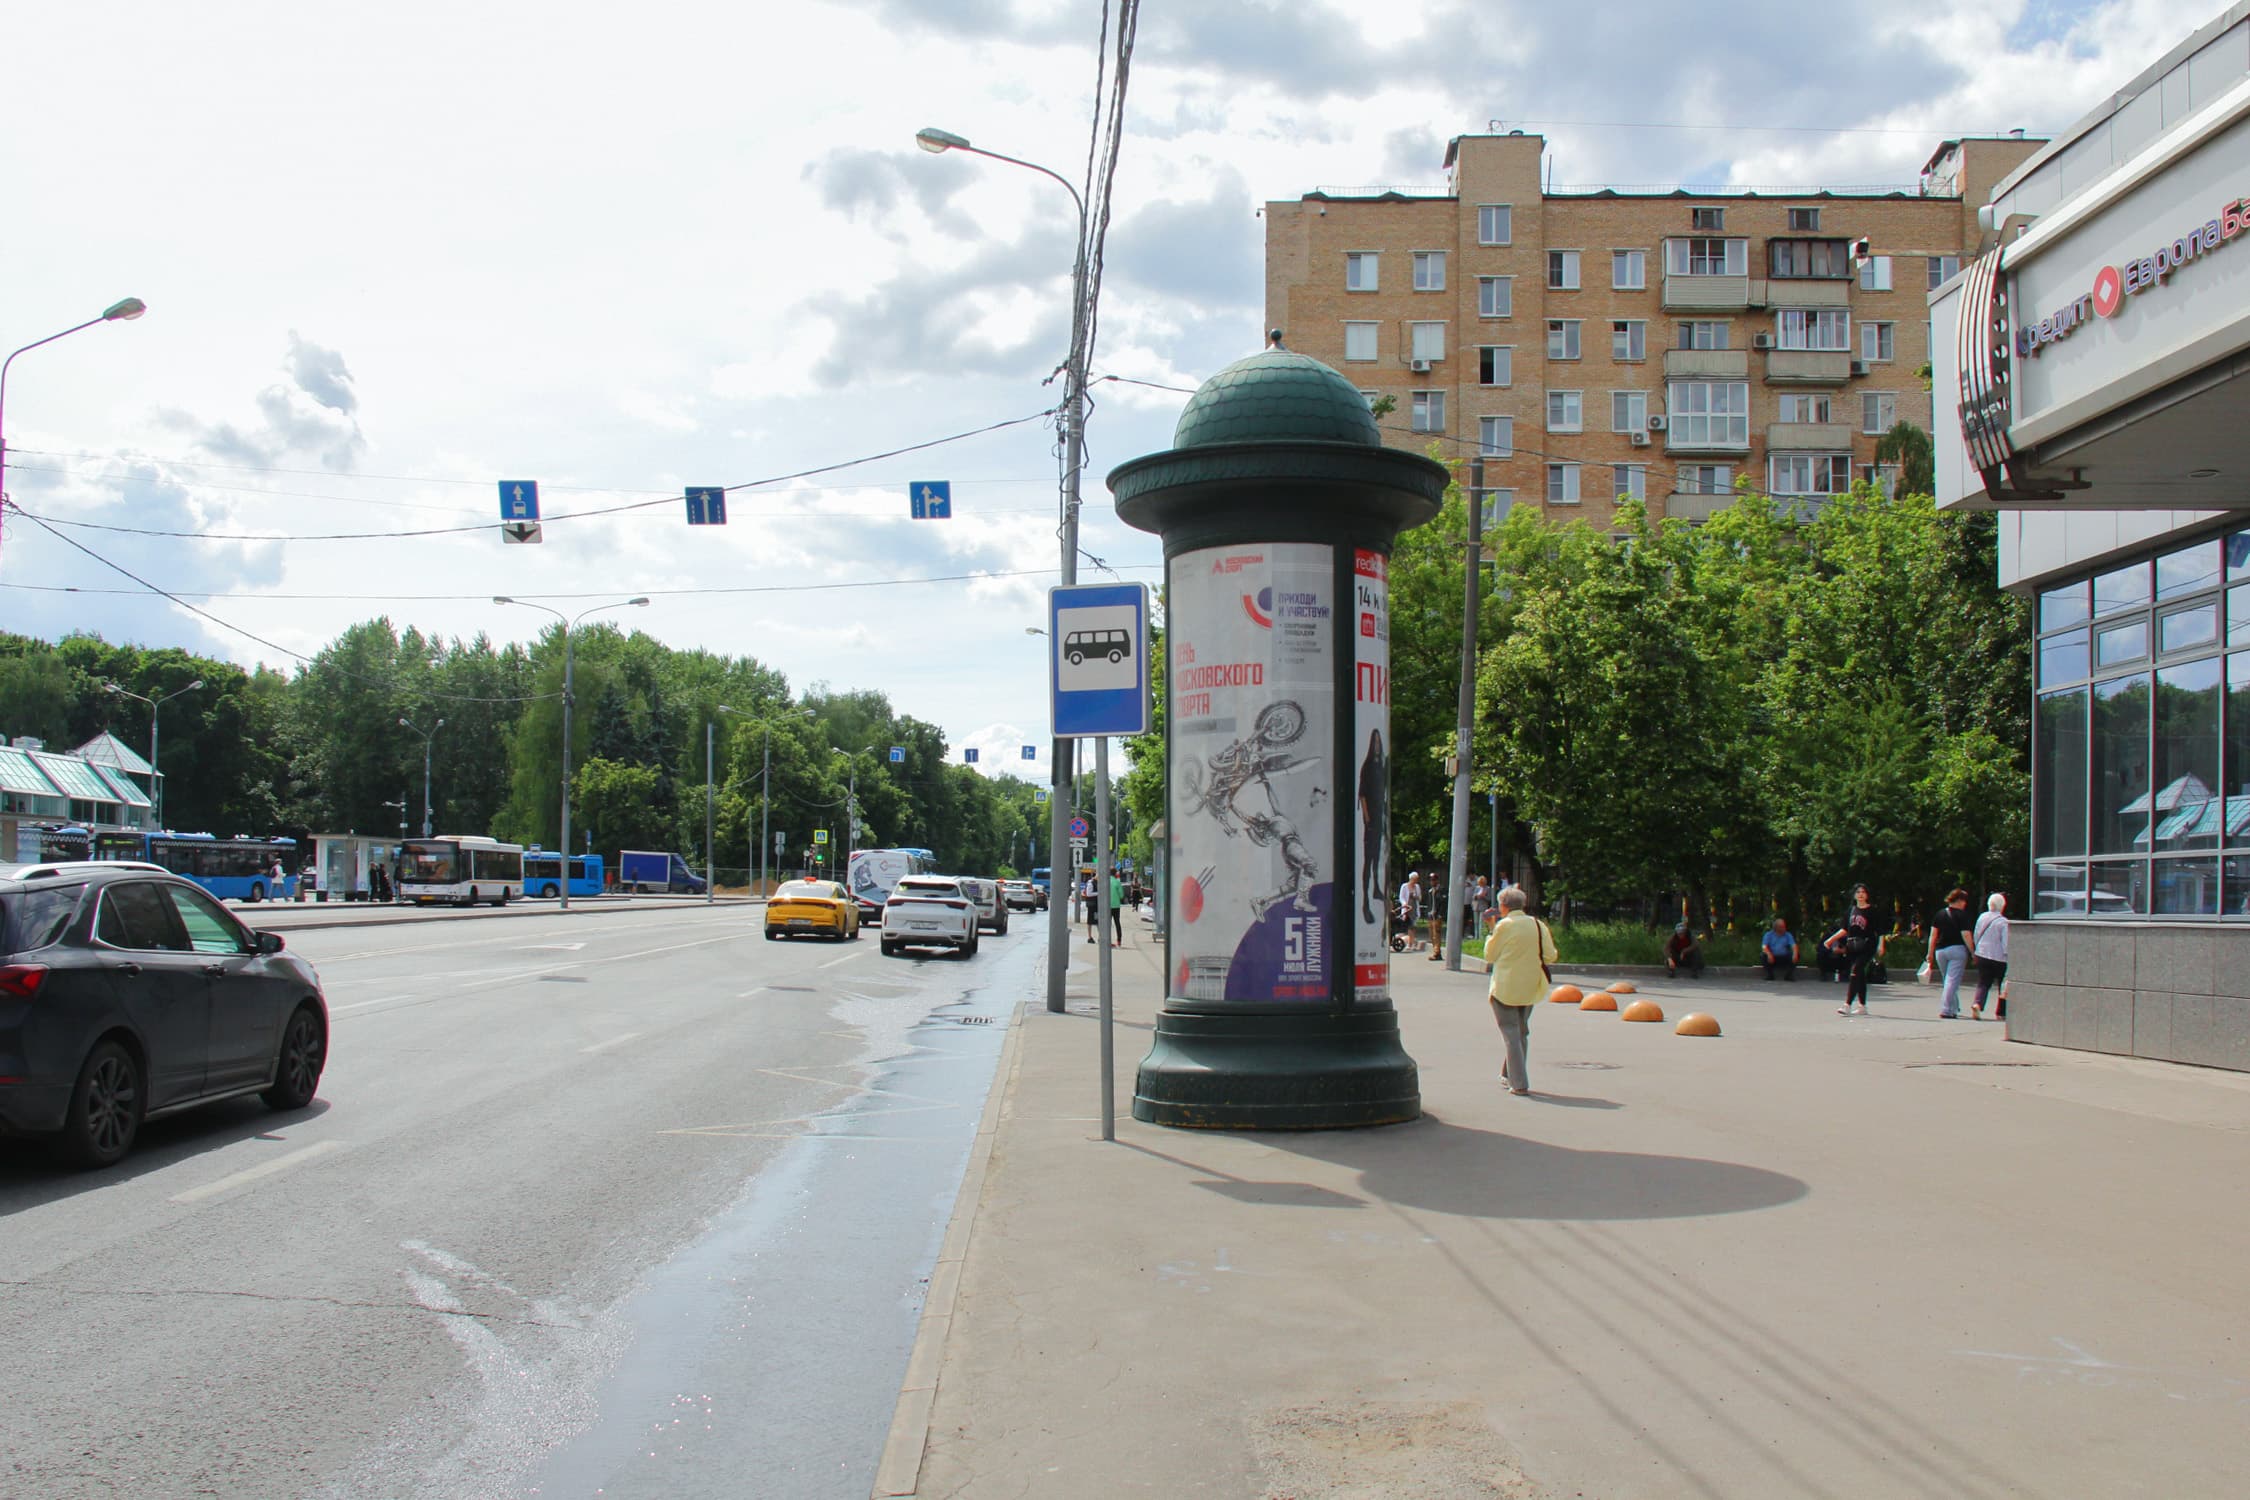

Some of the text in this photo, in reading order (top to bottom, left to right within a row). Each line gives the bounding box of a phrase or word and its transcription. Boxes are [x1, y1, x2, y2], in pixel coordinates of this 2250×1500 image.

[1278, 592, 1317, 606] ПРИХОДИ
[1358, 586, 1371, 607] 14
[1285, 917, 1303, 960] 5
[1306, 916, 1321, 973] ЛУЖНИКИ
